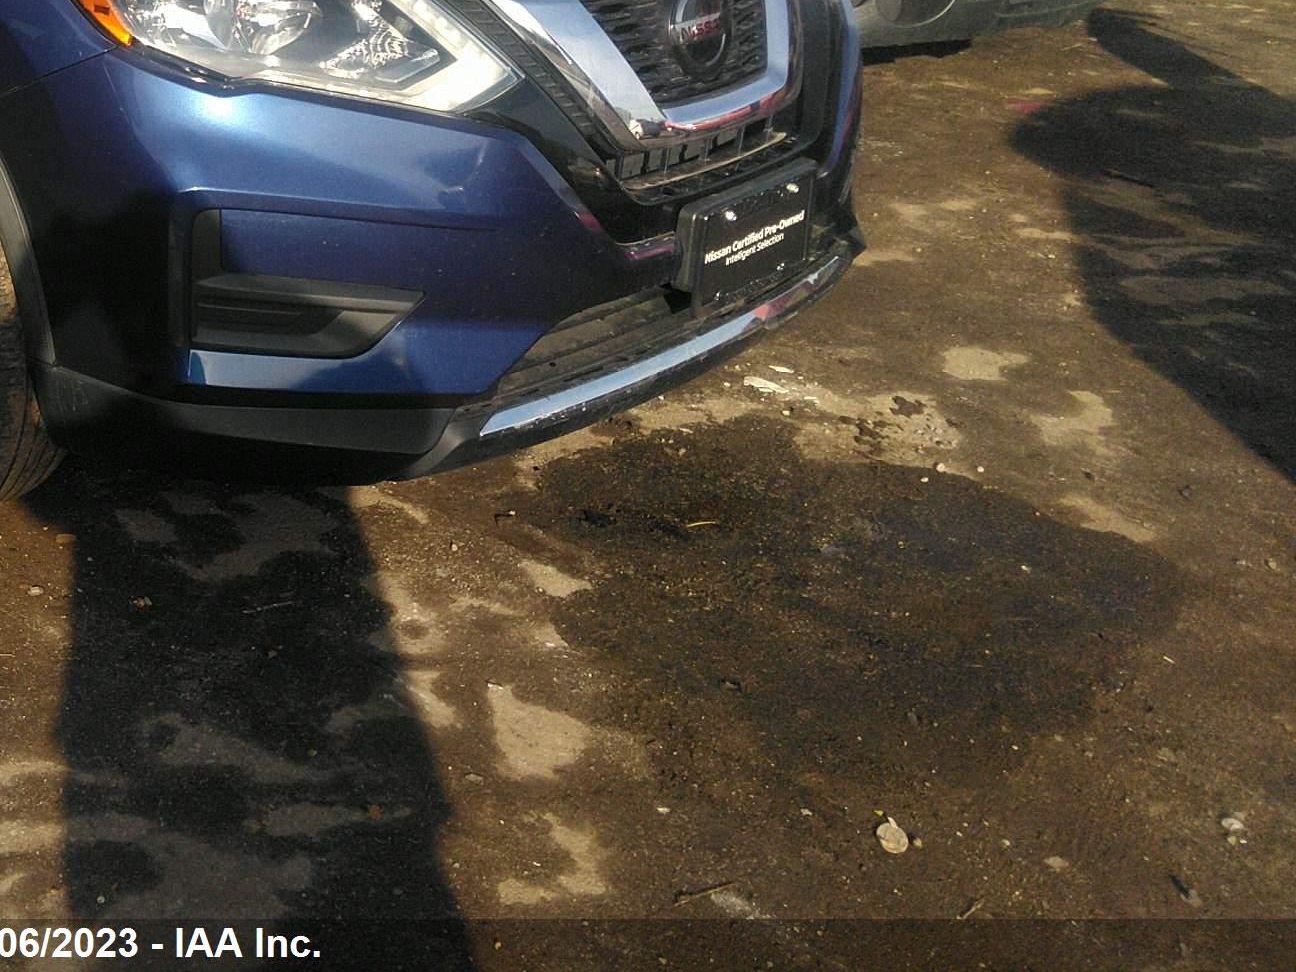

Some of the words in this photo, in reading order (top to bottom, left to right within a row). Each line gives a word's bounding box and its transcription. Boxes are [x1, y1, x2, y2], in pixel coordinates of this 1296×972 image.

[704, 245, 732, 265] Nissan
[732, 228, 765, 252] Certified
[764, 209, 805, 237] Pre-Owned
[725, 245, 757, 266] Intelligent
[756, 232, 785, 252] Selection
